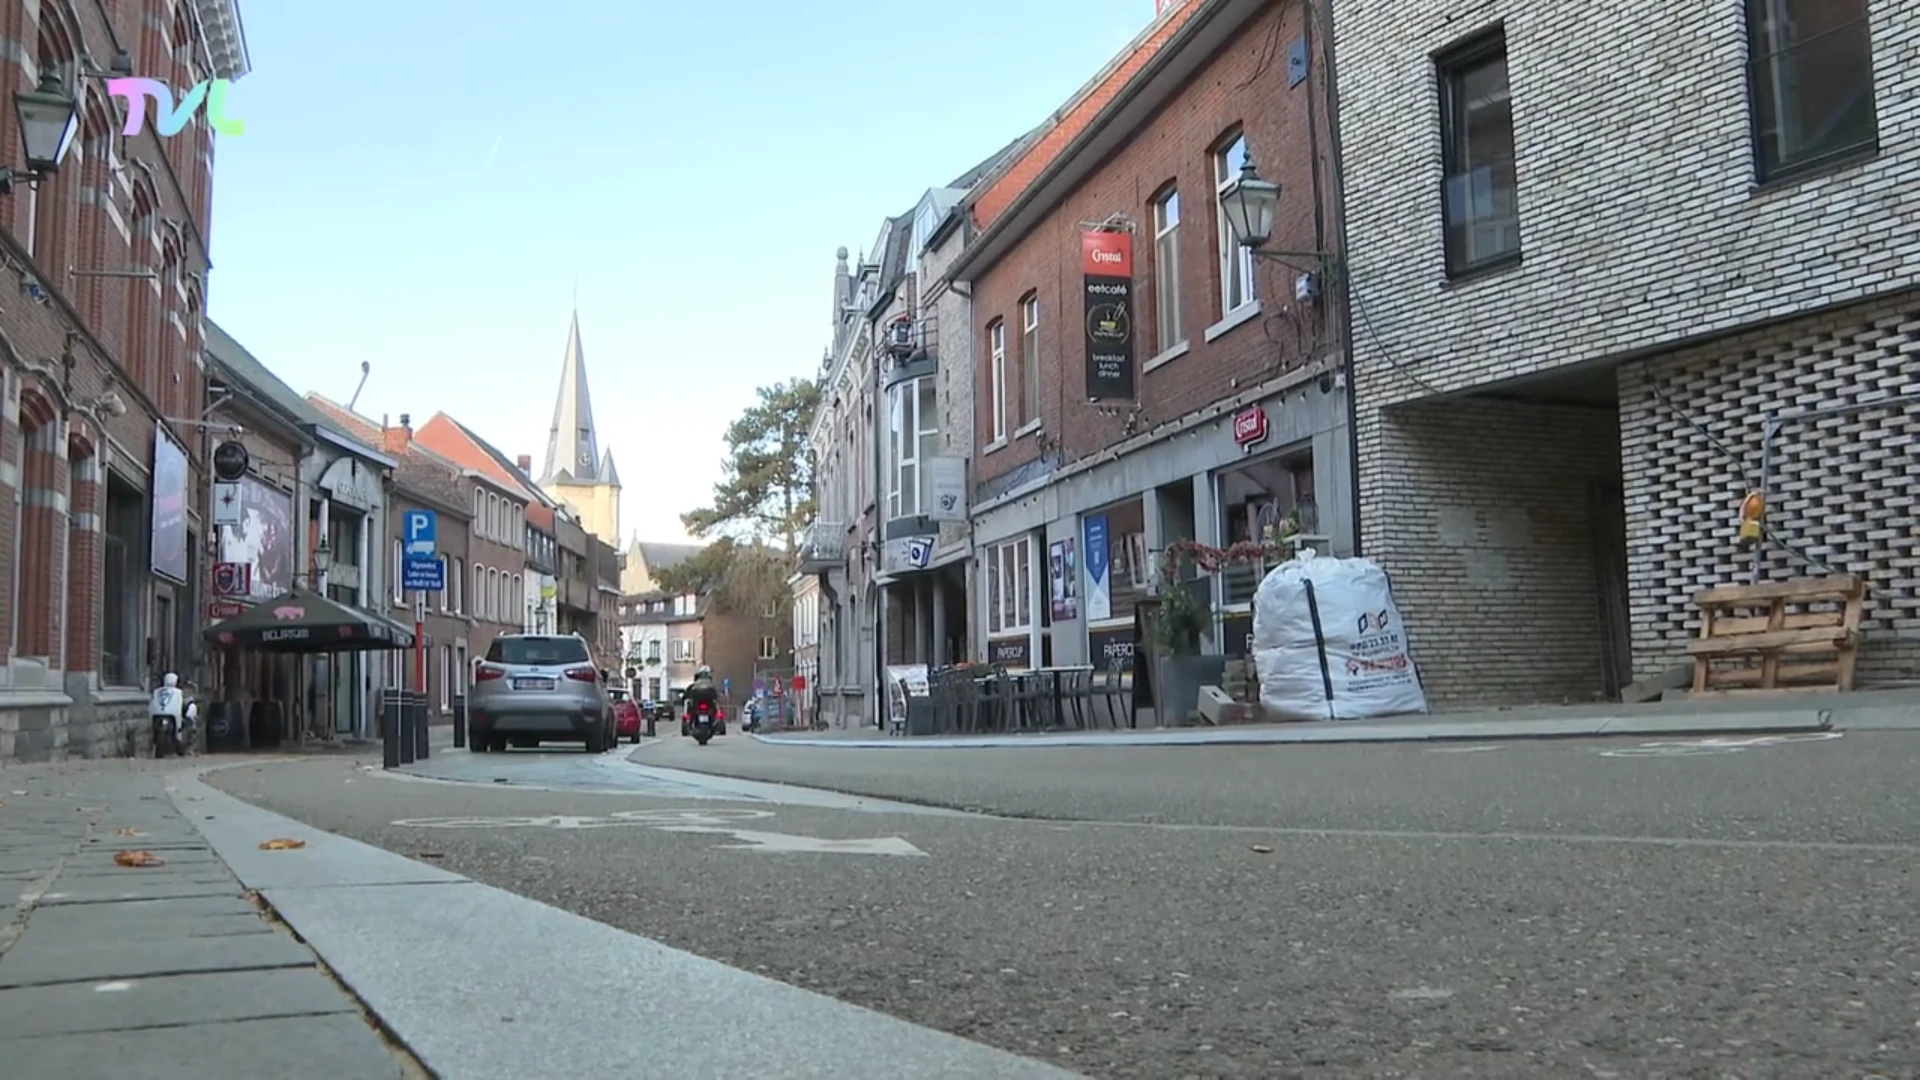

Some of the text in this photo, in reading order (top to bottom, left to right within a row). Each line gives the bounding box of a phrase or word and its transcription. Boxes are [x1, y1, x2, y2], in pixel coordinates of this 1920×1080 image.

[1092, 248, 1121, 263] Cristal
[1088, 284, 1127, 295] eetcafé
[1092, 353, 1125, 362] breakfast
[1099, 362, 1119, 370] lunch
[411, 514, 433, 539] P
